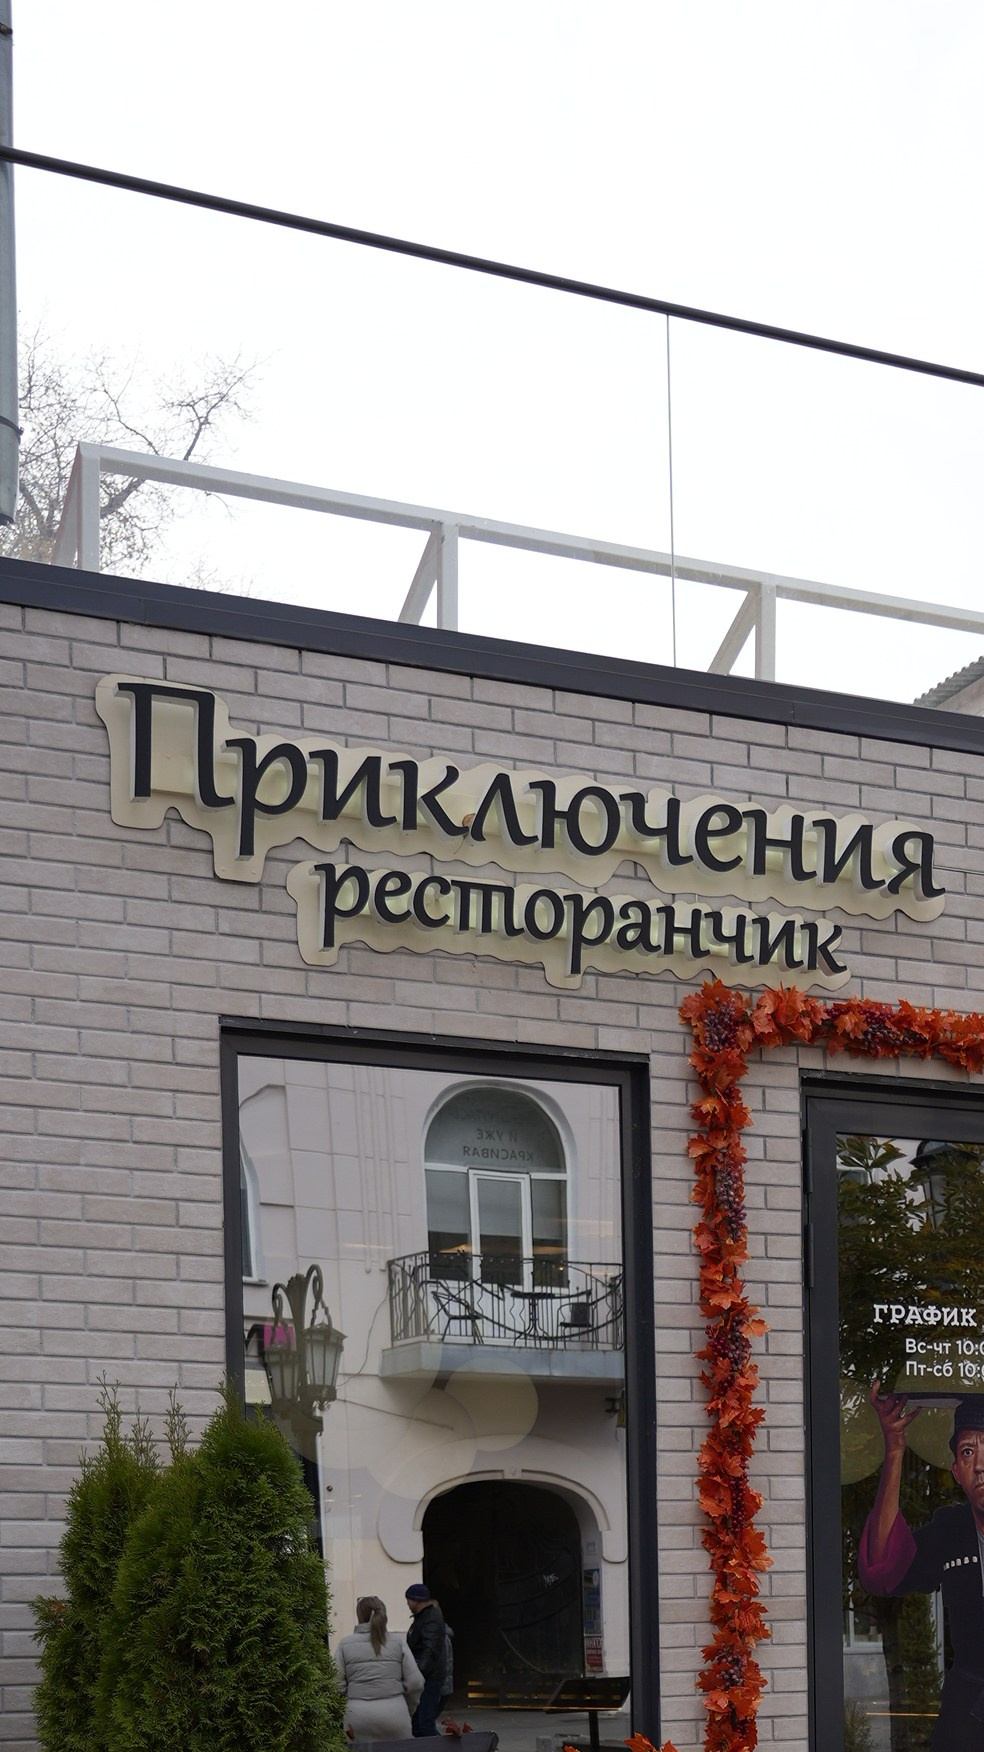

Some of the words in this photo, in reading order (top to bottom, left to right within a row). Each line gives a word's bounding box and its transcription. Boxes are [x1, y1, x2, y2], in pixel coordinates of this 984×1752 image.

[116, 682, 946, 900] Приключения
[313, 861, 847, 976] ресторанчик
[872, 1304, 978, 1328] ГРАФИК
[905, 1338, 951, 1355] Вс-чт
[905, 1361, 953, 1377] Пт-сб
